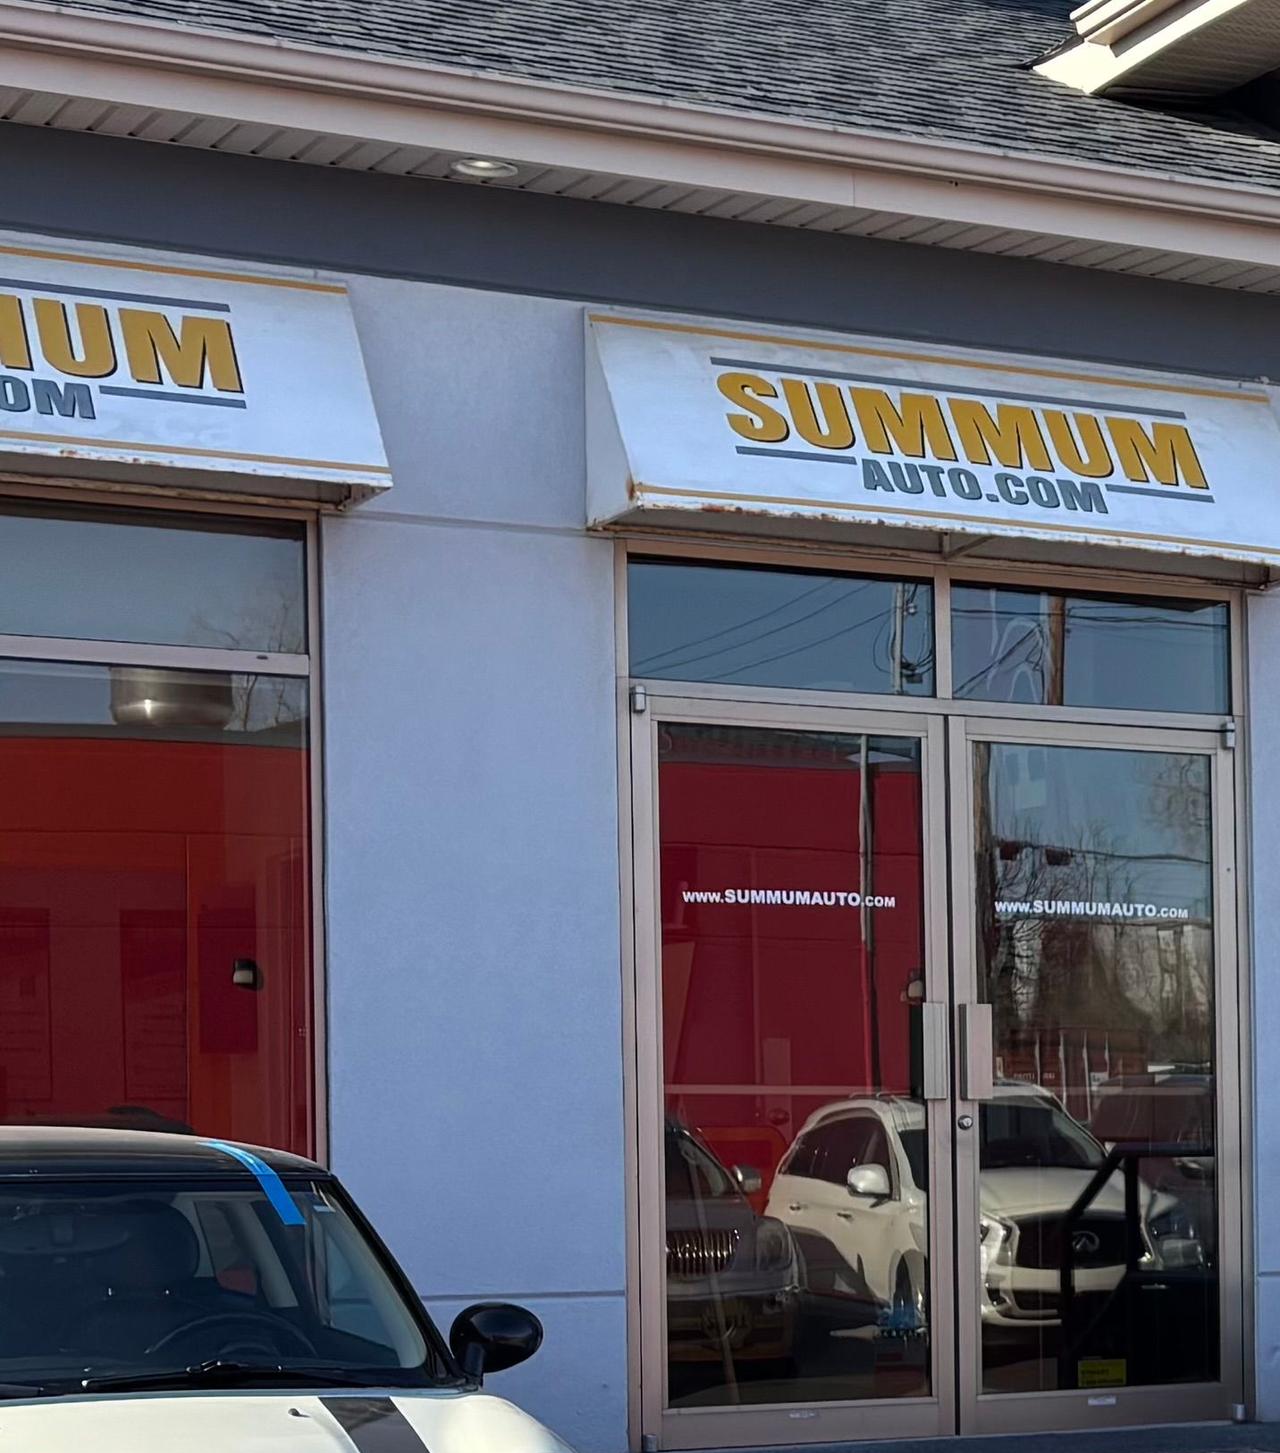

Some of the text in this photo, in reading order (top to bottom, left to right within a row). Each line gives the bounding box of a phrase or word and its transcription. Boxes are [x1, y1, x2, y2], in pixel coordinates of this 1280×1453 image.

[0, 294, 244, 394] UM
[716, 371, 1209, 490] SUMMUM
[862, 458, 1109, 514] AUTO.COM
